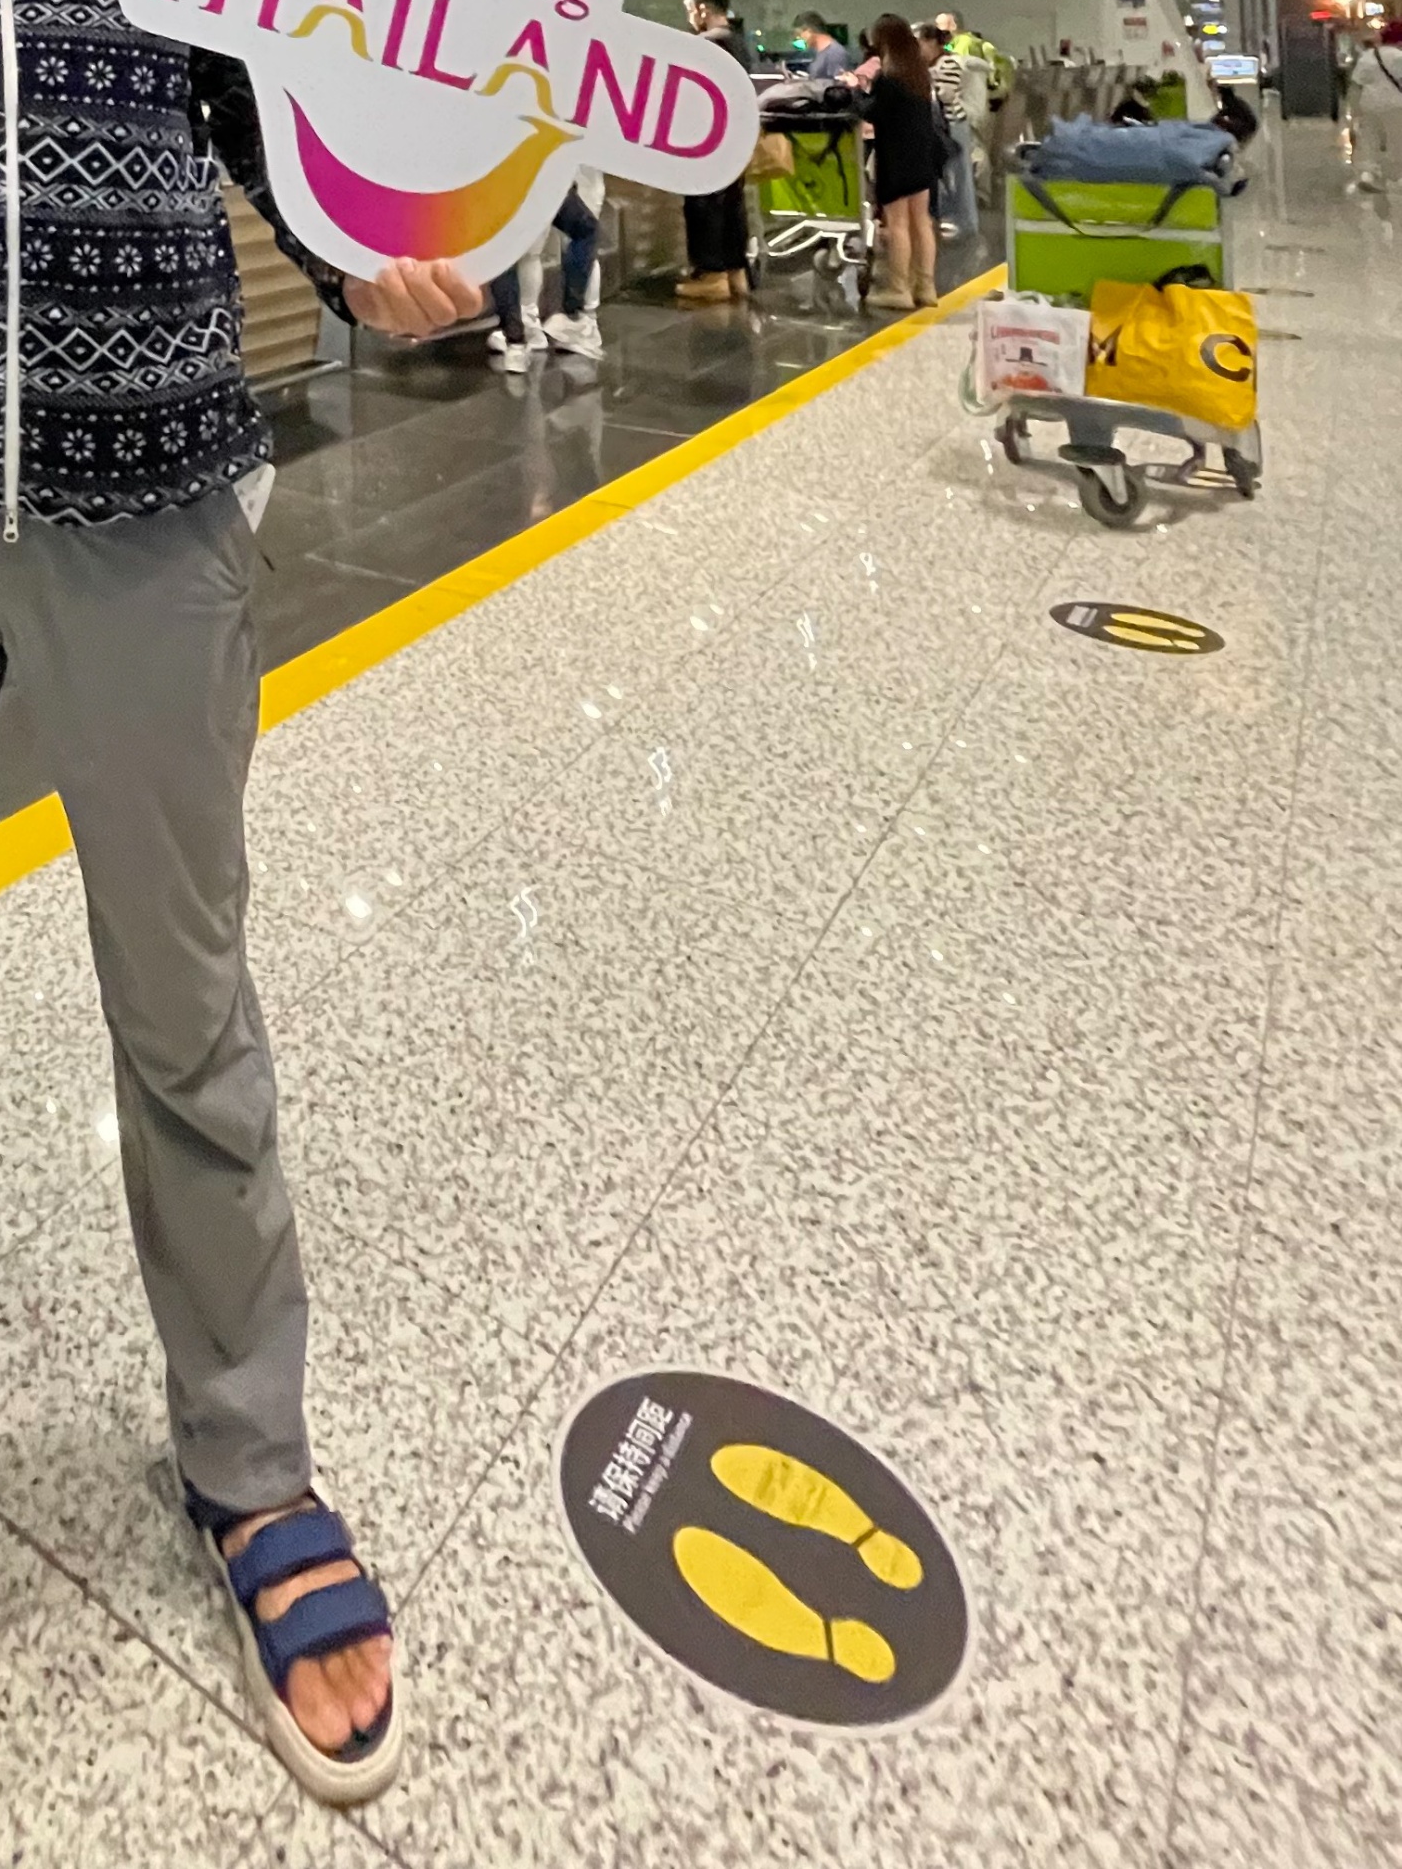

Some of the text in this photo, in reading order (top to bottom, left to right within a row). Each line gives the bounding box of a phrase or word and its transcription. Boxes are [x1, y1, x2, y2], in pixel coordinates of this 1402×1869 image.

[588, 1395, 674, 1522] 请保持间距
